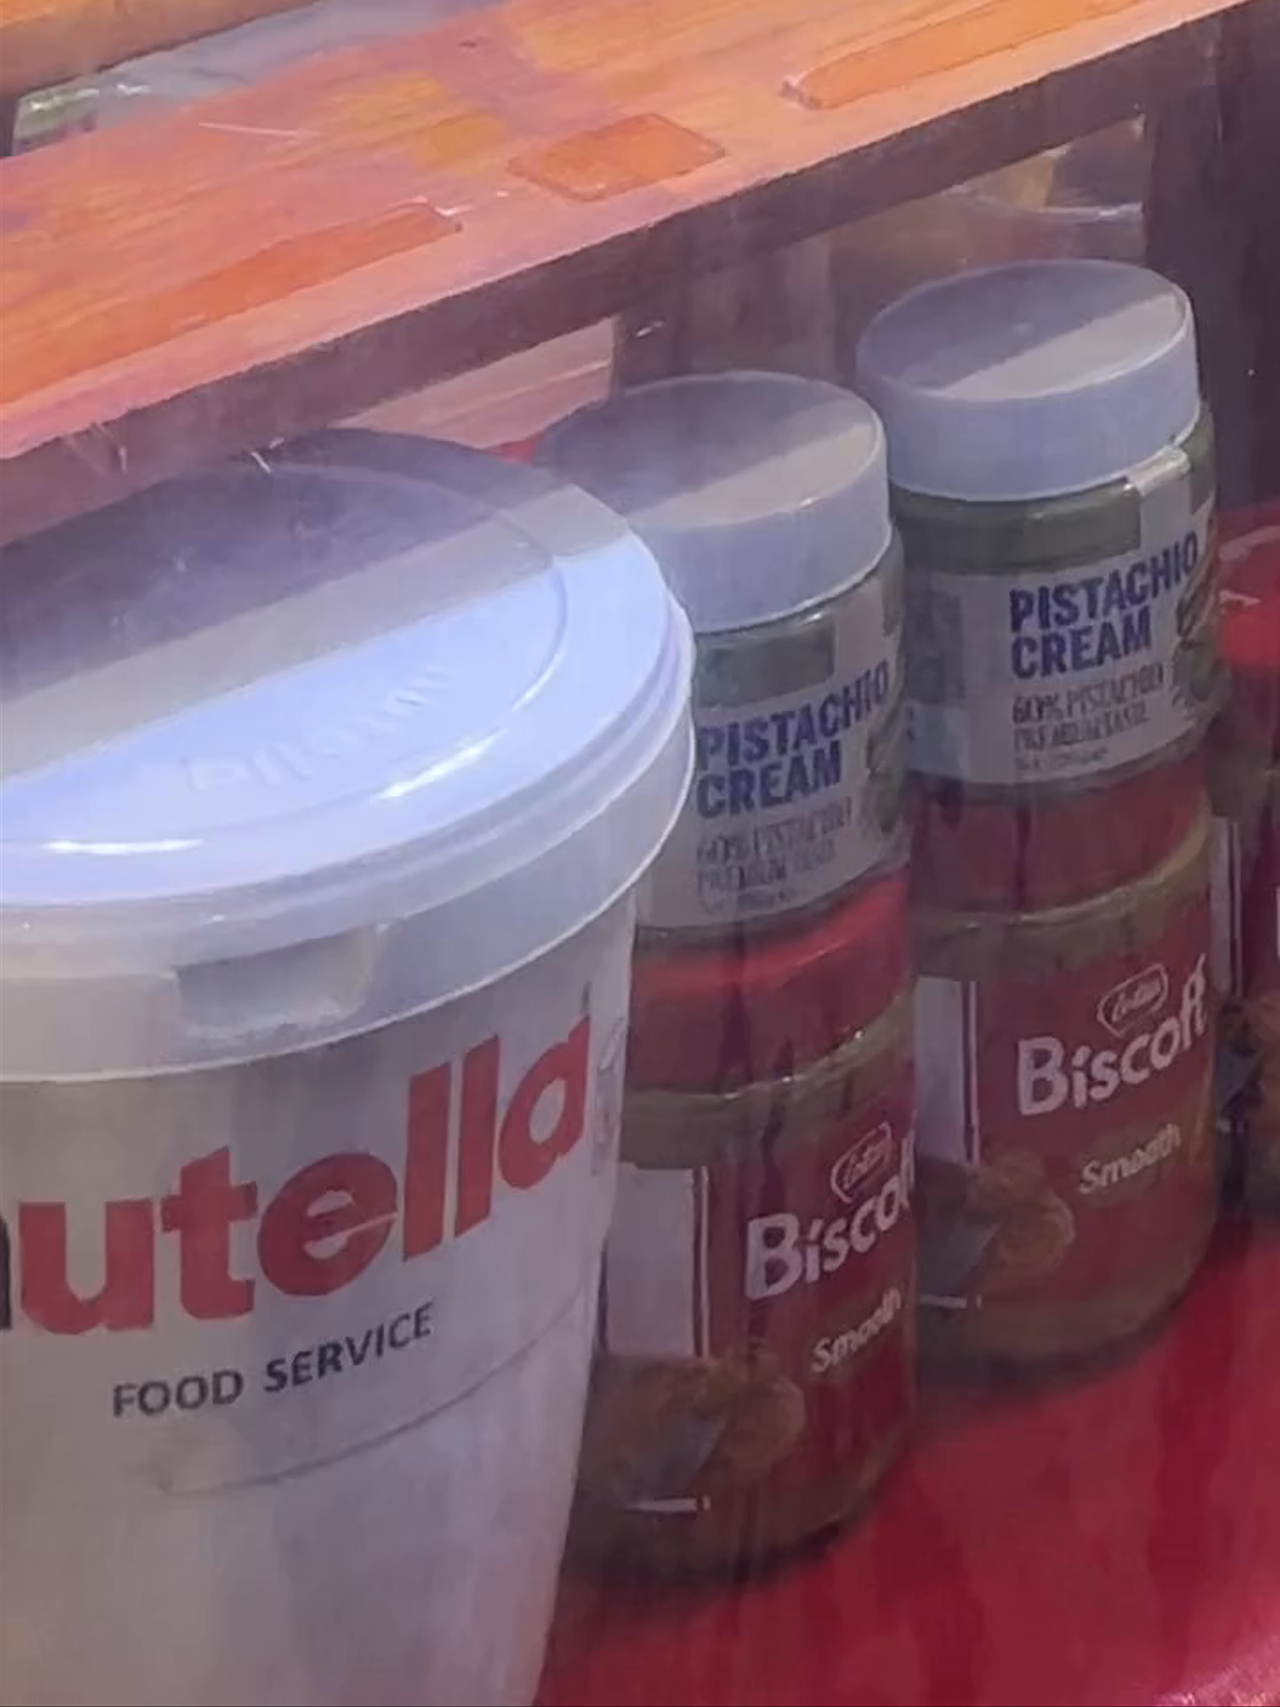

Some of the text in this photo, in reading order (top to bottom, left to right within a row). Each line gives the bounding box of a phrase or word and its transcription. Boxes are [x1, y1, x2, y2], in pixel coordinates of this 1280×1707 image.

[1009, 531, 1199, 633] PISTACHIO
[1010, 605, 1152, 680] CREAM
[699, 659, 890, 770] PISTACHIO
[697, 740, 841, 819] CREAM
[1018, 952, 1205, 1116] Biscoff
[0, 1013, 590, 1336] utella
[1079, 1123, 1181, 1194] Smooth
[112, 1301, 434, 1417] FOOD SERVICE
